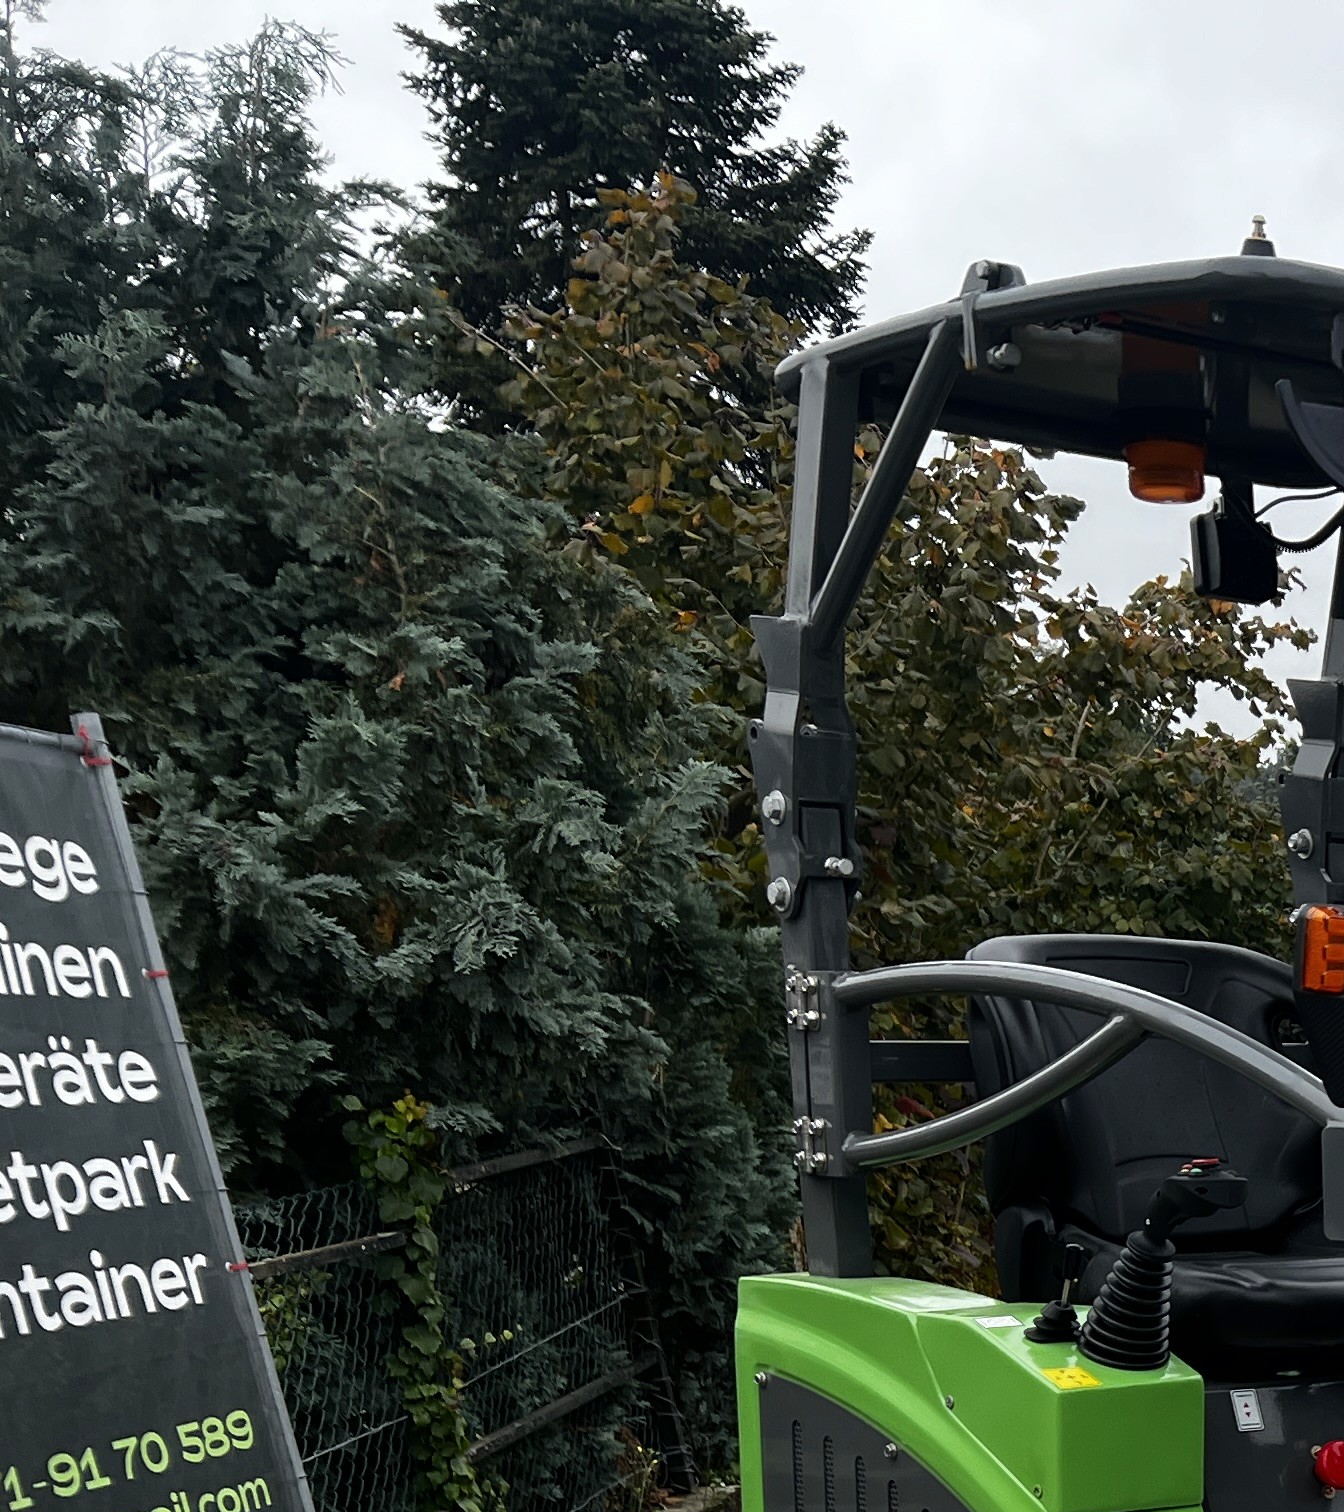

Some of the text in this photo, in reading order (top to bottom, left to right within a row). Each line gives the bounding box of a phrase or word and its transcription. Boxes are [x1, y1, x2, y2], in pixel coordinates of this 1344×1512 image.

[0, 831, 100, 902] ege
[0, 921, 132, 999] inen
[0, 1035, 159, 1109] eräte
[0, 1249, 207, 1338] ntainer
[0, 1409, 254, 1511] 1-91 70 589
